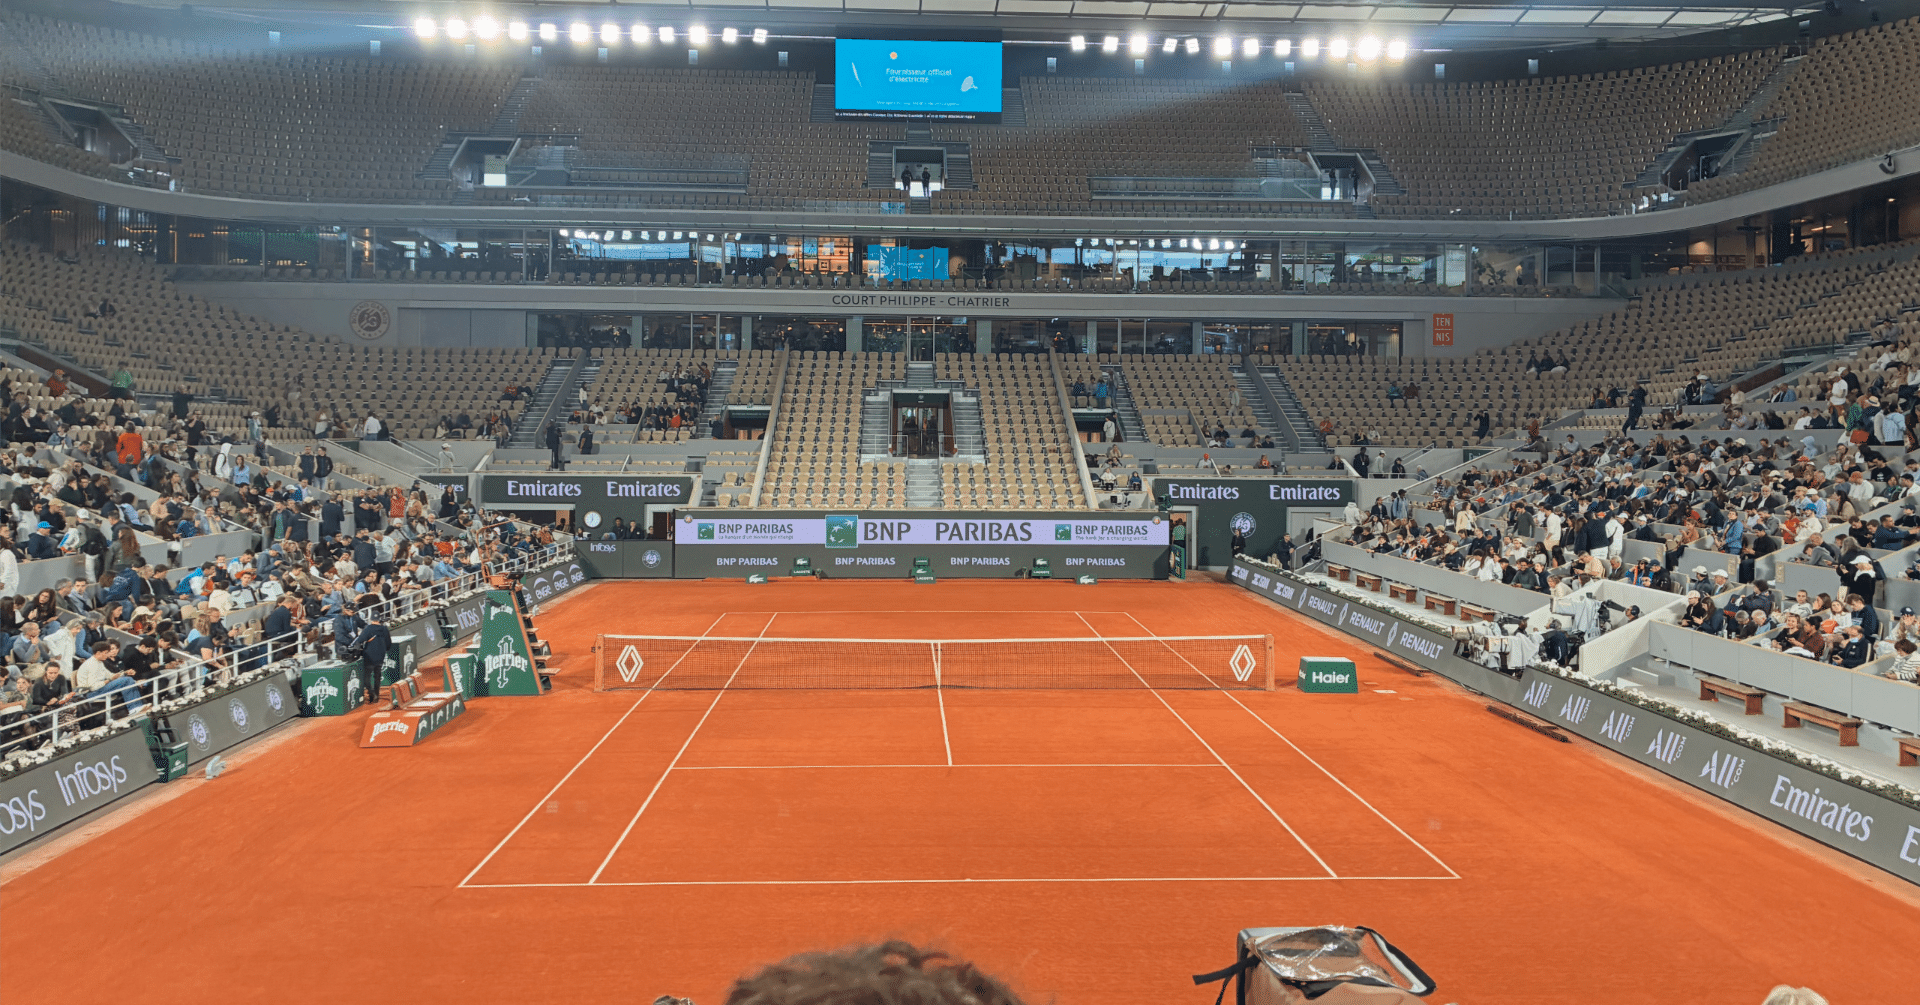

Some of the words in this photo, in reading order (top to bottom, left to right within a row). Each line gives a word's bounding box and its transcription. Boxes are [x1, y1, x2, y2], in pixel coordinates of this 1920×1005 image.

[928, 68, 952, 77] officiel
[832, 295, 876, 305] COURT
[880, 296, 936, 306] PHILIPPE
[947, 297, 1010, 307] CHATRIER
[1436, 317, 1451, 327] TEN
[1436, 332, 1450, 341] NIS
[507, 480, 582, 497] Emirates
[606, 480, 681, 497] Emirates
[1168, 483, 1240, 500] Emirates
[1269, 484, 1340, 500] Emirates
[718, 523, 742, 534] BNP
[745, 523, 793, 534] PARIBAS
[863, 522, 911, 541] BNP
[935, 521, 1032, 542] PARIBAS
[1075, 525, 1098, 535] BNP
[1101, 525, 1148, 535] PARIBAS
[590, 542, 617, 554] Infosys
[716, 557, 736, 566] BNP
[738, 557, 778, 566] PARIBAS
[835, 557, 855, 566] BNP
[856, 557, 896, 566] PARIBAS
[950, 557, 970, 566] BNP
[971, 557, 1010, 566] PARIBAS
[1066, 557, 1085, 566] BNP
[1087, 557, 1126, 566] PARIBAS
[1307, 595, 1338, 616] RENAULT
[1349, 611, 1386, 636] RENAULT
[1400, 631, 1444, 660] RENAULT
[1311, 671, 1350, 684] Haier
[55, 755, 127, 807] Infosys
[1769, 774, 1874, 842] Emirates
